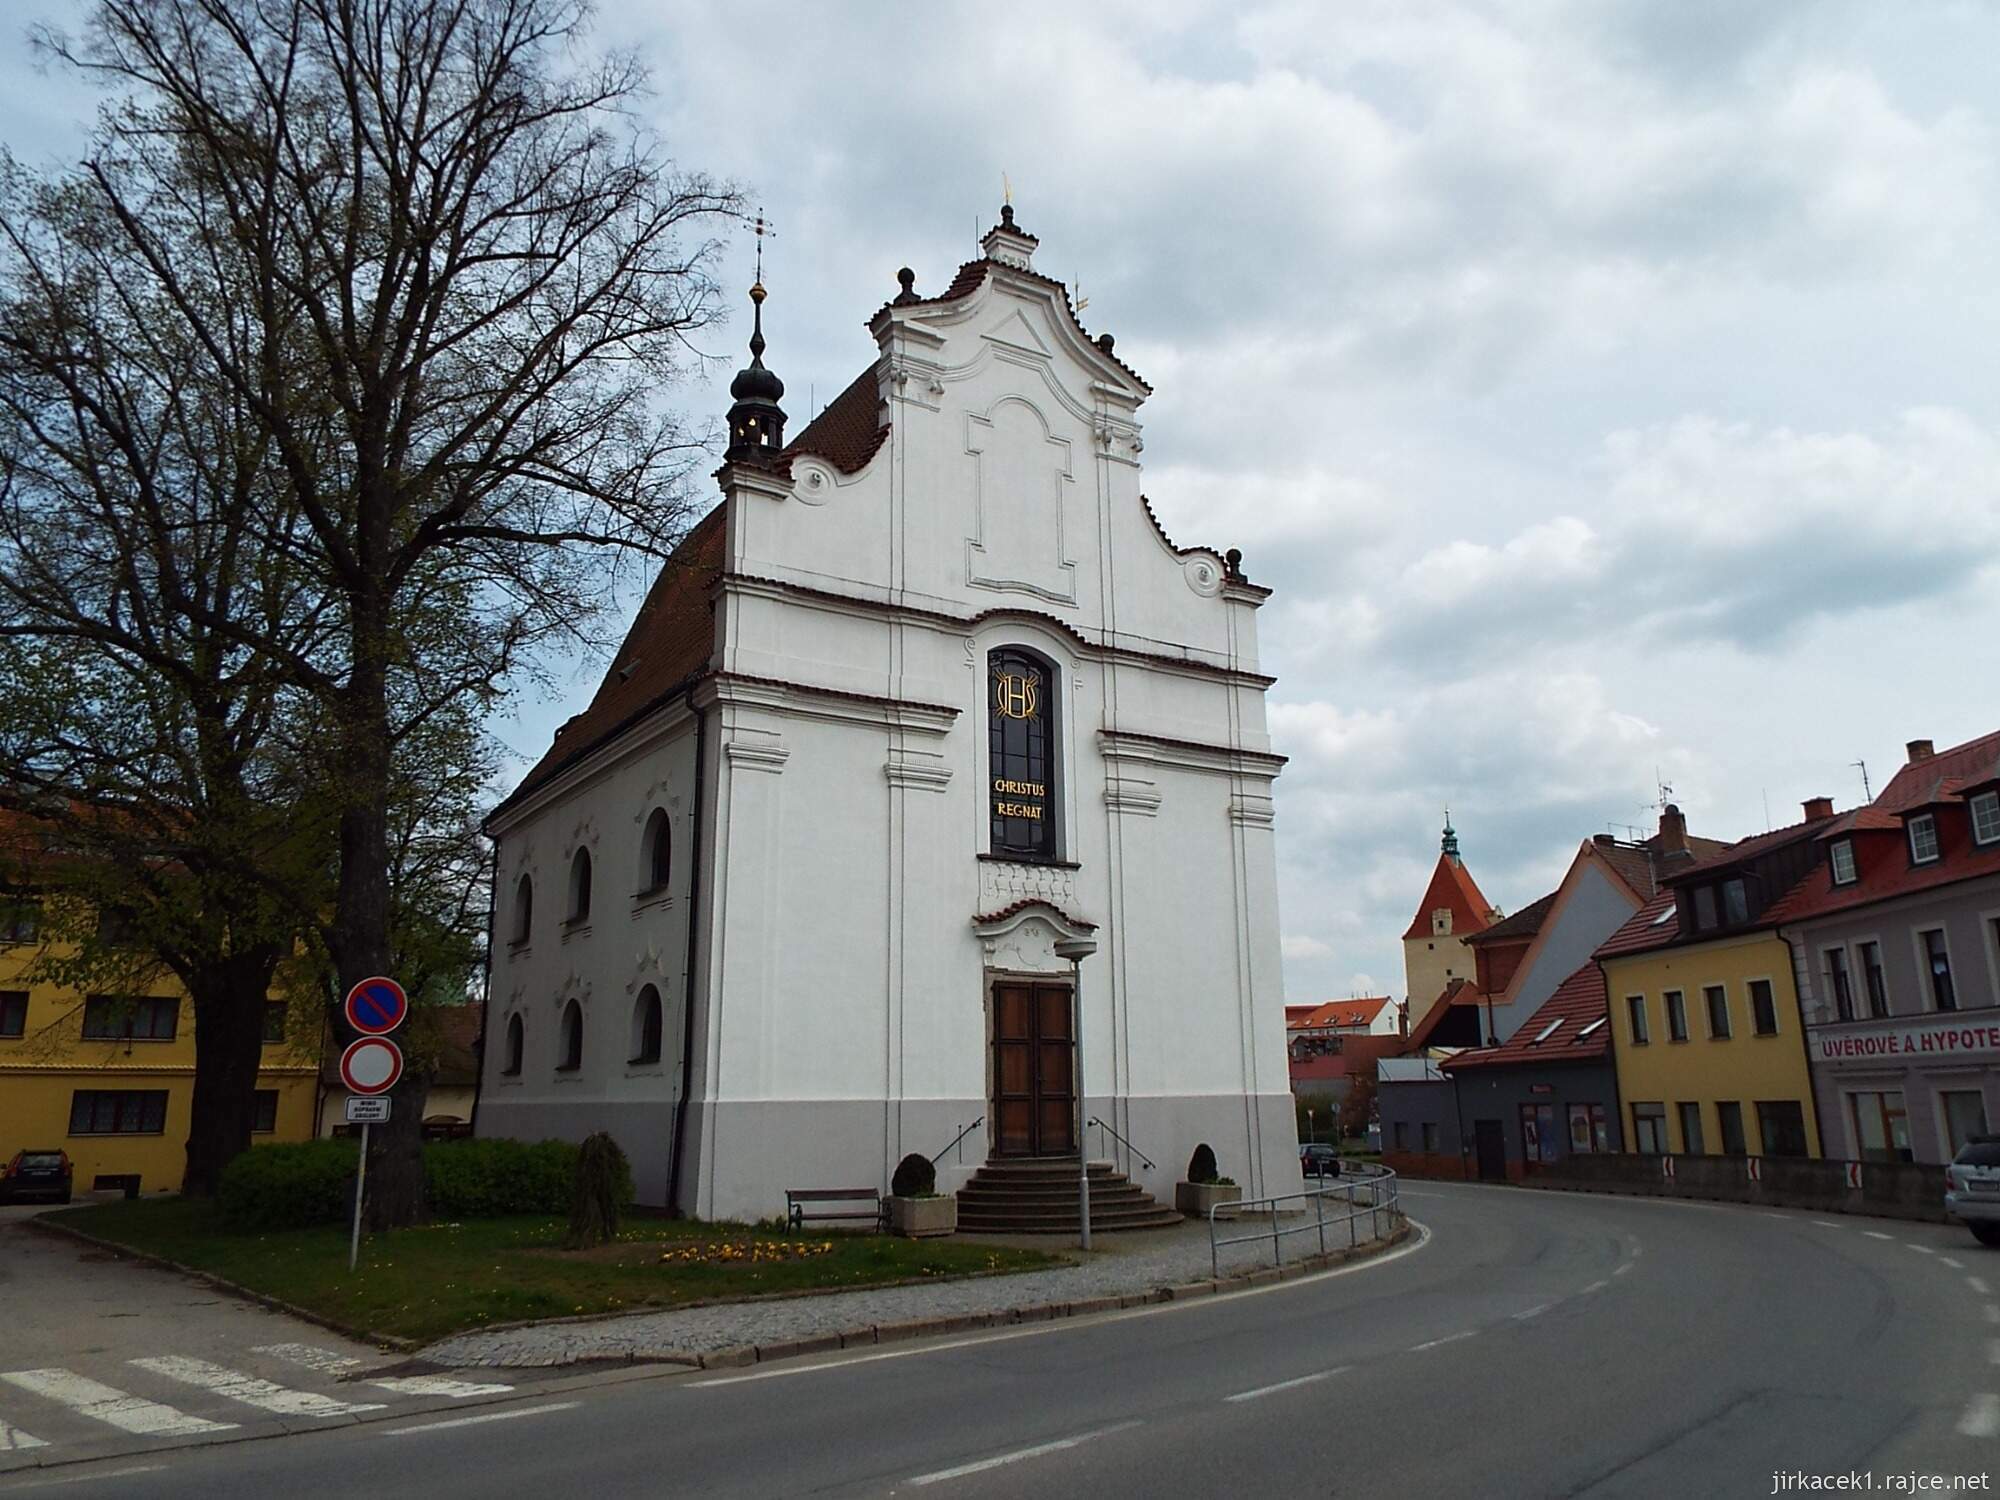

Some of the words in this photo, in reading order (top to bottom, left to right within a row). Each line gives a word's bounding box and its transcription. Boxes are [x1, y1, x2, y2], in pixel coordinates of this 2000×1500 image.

[995, 780, 1045, 796] CHRISTUS
[998, 802, 1042, 819] REGNAT
[1904, 1034, 1916, 1053] A
[1920, 1028, 2000, 1051] HYPOTE
